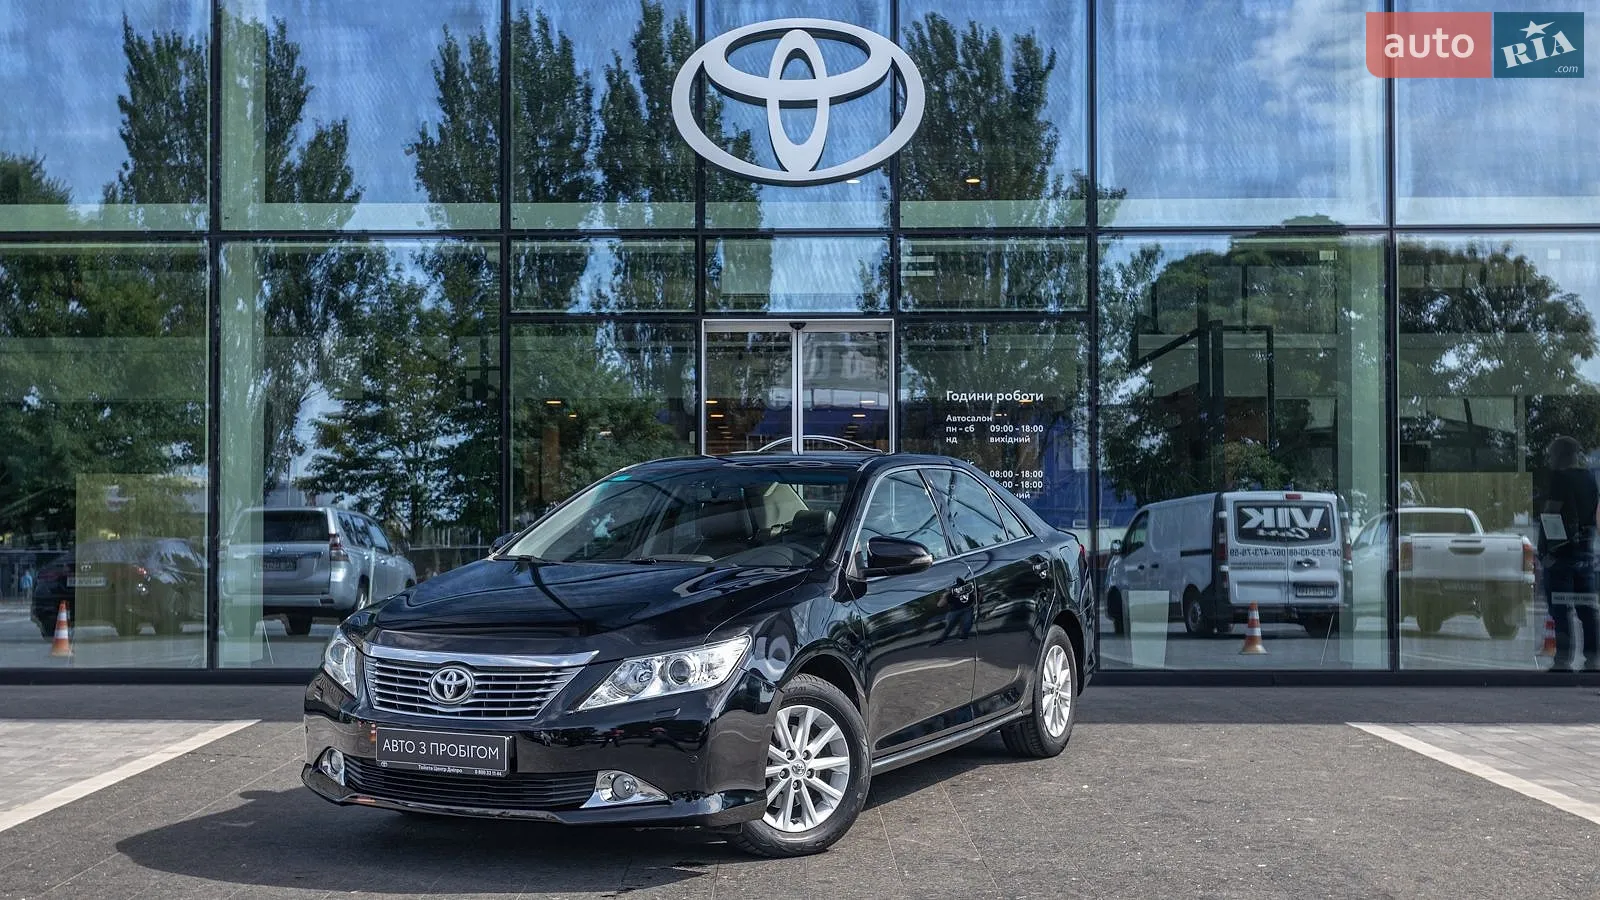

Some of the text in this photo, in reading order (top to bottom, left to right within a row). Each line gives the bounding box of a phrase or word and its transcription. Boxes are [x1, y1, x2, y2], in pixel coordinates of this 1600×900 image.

[946, 390, 1044, 403] Години роботи
[946, 414, 993, 423] Автосалон
[964, 424, 975, 433] сб
[989, 424, 1014, 433] 09:00
[1021, 424, 1044, 433] 18:00
[946, 434, 1031, 445] нд вихідний
[989, 470, 1014, 478] 08:00
[1020, 470, 1044, 478] 18:00
[1020, 480, 1043, 489] 18:00
[382, 738, 416, 754] АВТО
[430, 742, 499, 760] ПРОБІГОМ
